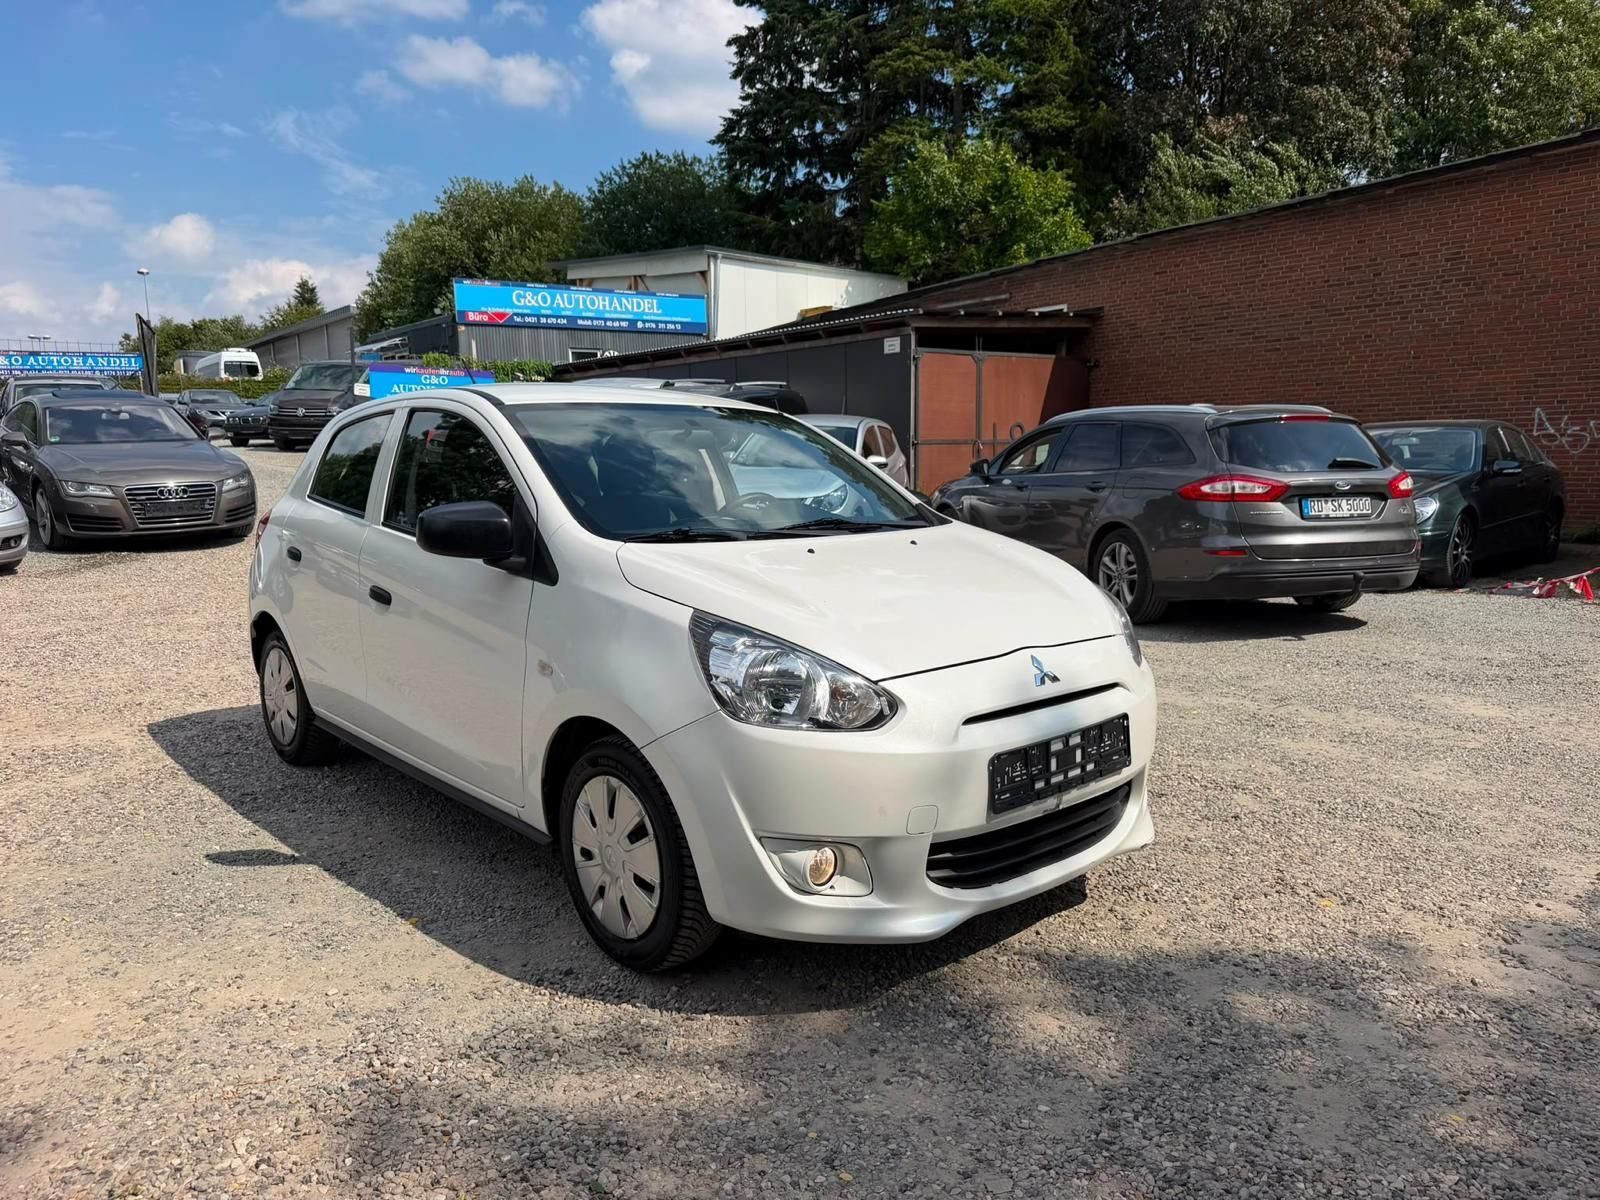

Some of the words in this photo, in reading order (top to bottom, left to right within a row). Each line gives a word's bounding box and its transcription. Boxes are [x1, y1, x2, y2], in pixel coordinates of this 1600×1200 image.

[512, 290, 551, 307] G&O
[553, 293, 662, 314] AUTOHANDEL
[468, 311, 489, 322] Büro
[27, 356, 139, 367] AUTOHANDEL
[404, 366, 465, 377] wirkaufenihrauto
[421, 375, 448, 385] G&O
[1310, 499, 1323, 513] RD
[1331, 499, 1345, 512] SK
[1347, 498, 1371, 512] 5000
